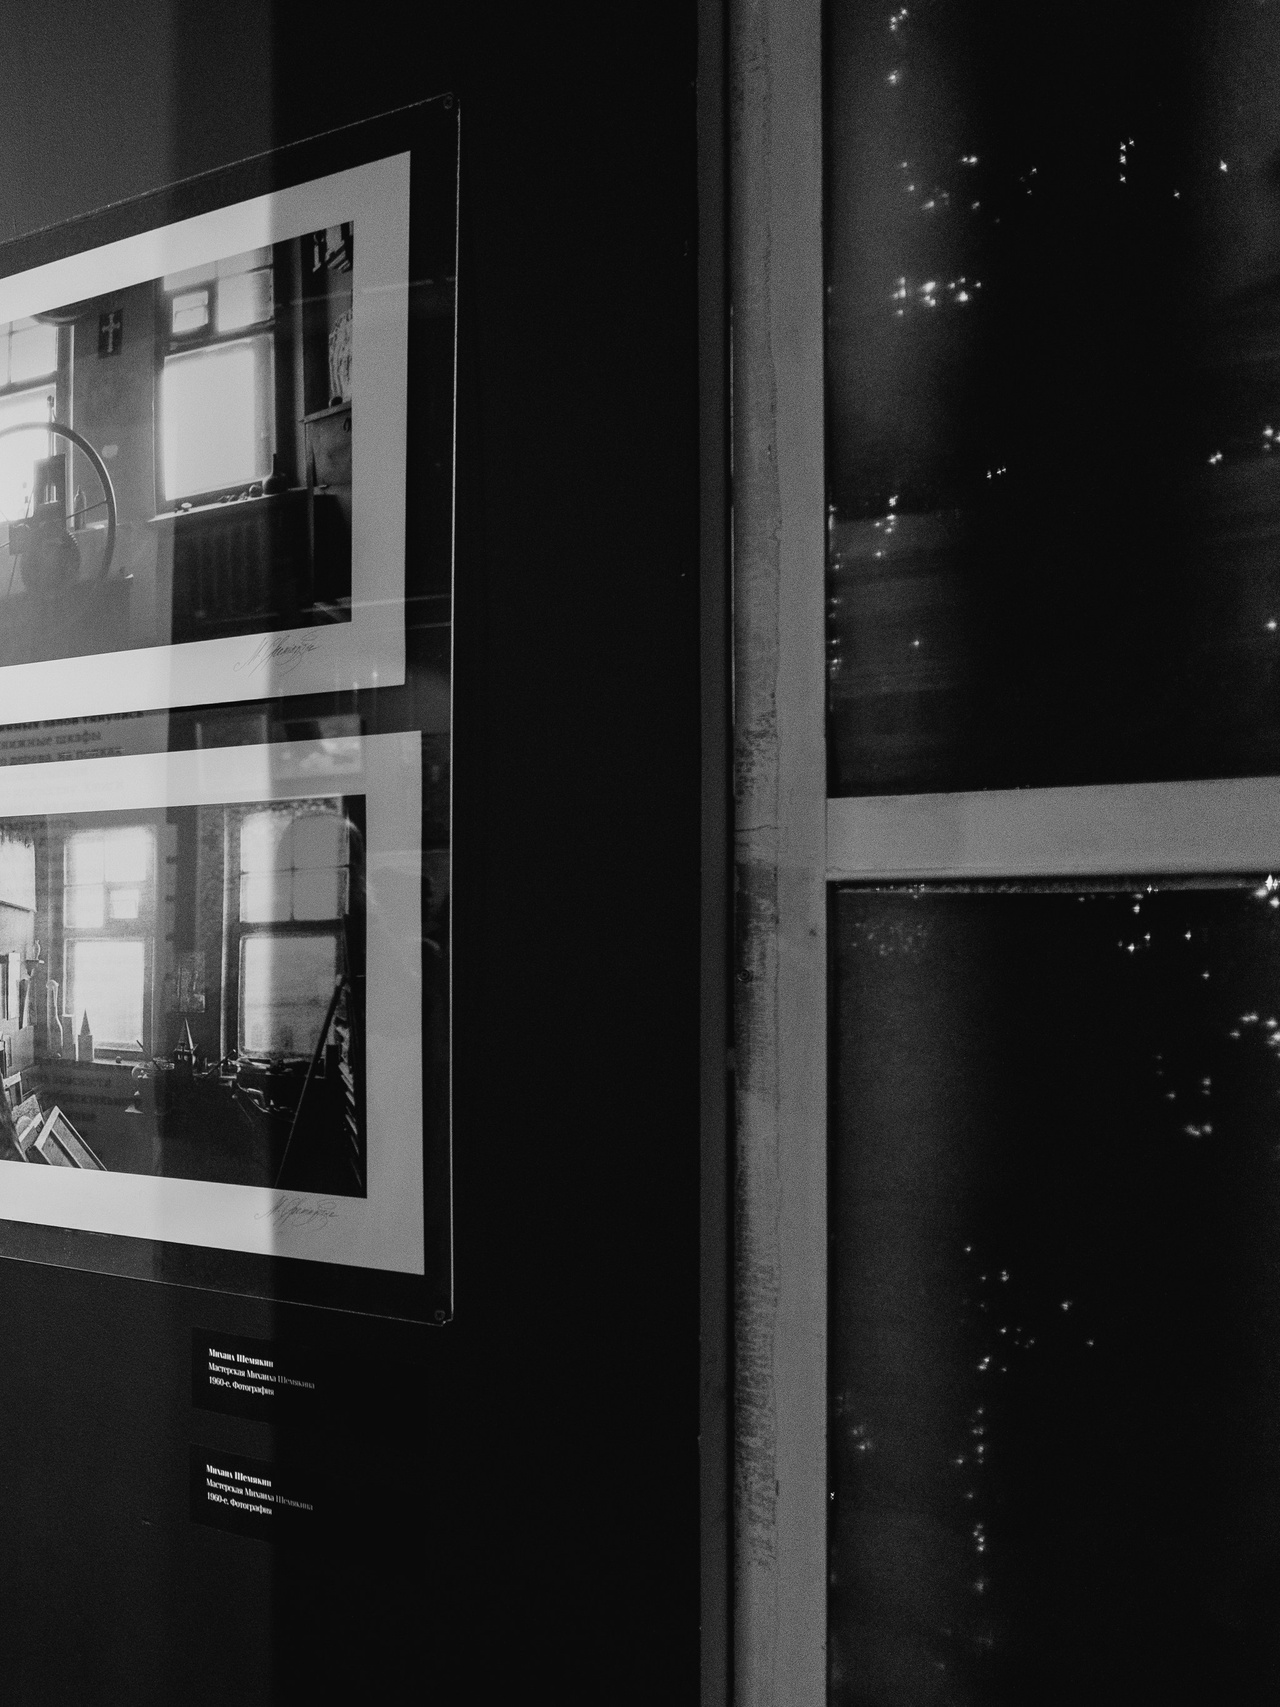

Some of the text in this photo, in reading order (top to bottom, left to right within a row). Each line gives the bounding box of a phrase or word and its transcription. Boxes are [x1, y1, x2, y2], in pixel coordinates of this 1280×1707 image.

[56, 730, 102, 746] шкафы
[208, 1348, 274, 1368] Михаил Шемякин
[208, 1362, 316, 1389] Мастерская Михаила Шемякина
[232, 1381, 275, 1396] Фотография
[206, 1464, 272, 1487] Михаил Шемякин
[206, 1478, 314, 1511] Мастерская Михаила Шемякина
[230, 1498, 273, 1515] Фотография
